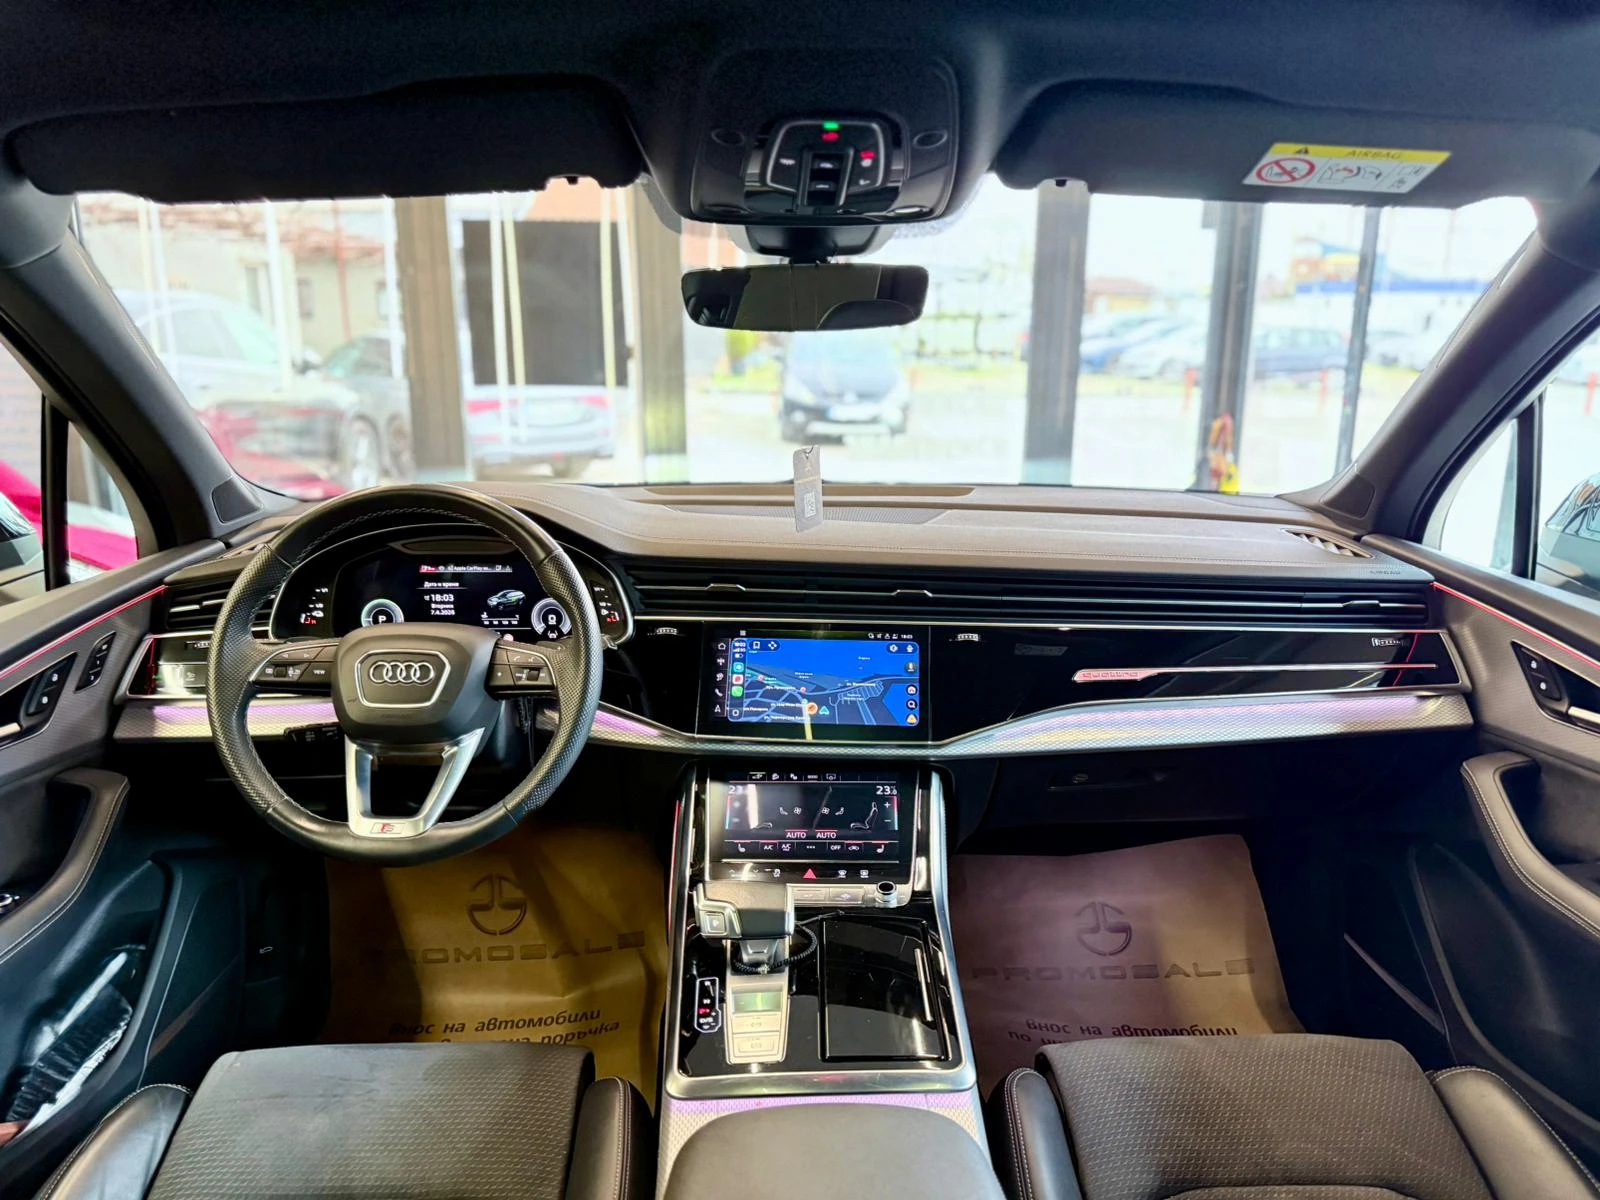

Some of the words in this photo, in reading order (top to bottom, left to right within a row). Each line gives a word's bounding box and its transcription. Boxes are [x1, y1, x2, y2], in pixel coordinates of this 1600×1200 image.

[1347, 149, 1403, 160] AIRBAG
[431, 594, 455, 602] 18:03
[378, 615, 387, 625] P
[1082, 671, 1139, 679] quattro
[972, 958, 1256, 981] PROMOSALE
[443, 1022, 465, 1034] на
[475, 1008, 601, 1034] автомобили
[1008, 1029, 1032, 1042] по
[1080, 1024, 1102, 1037] на
